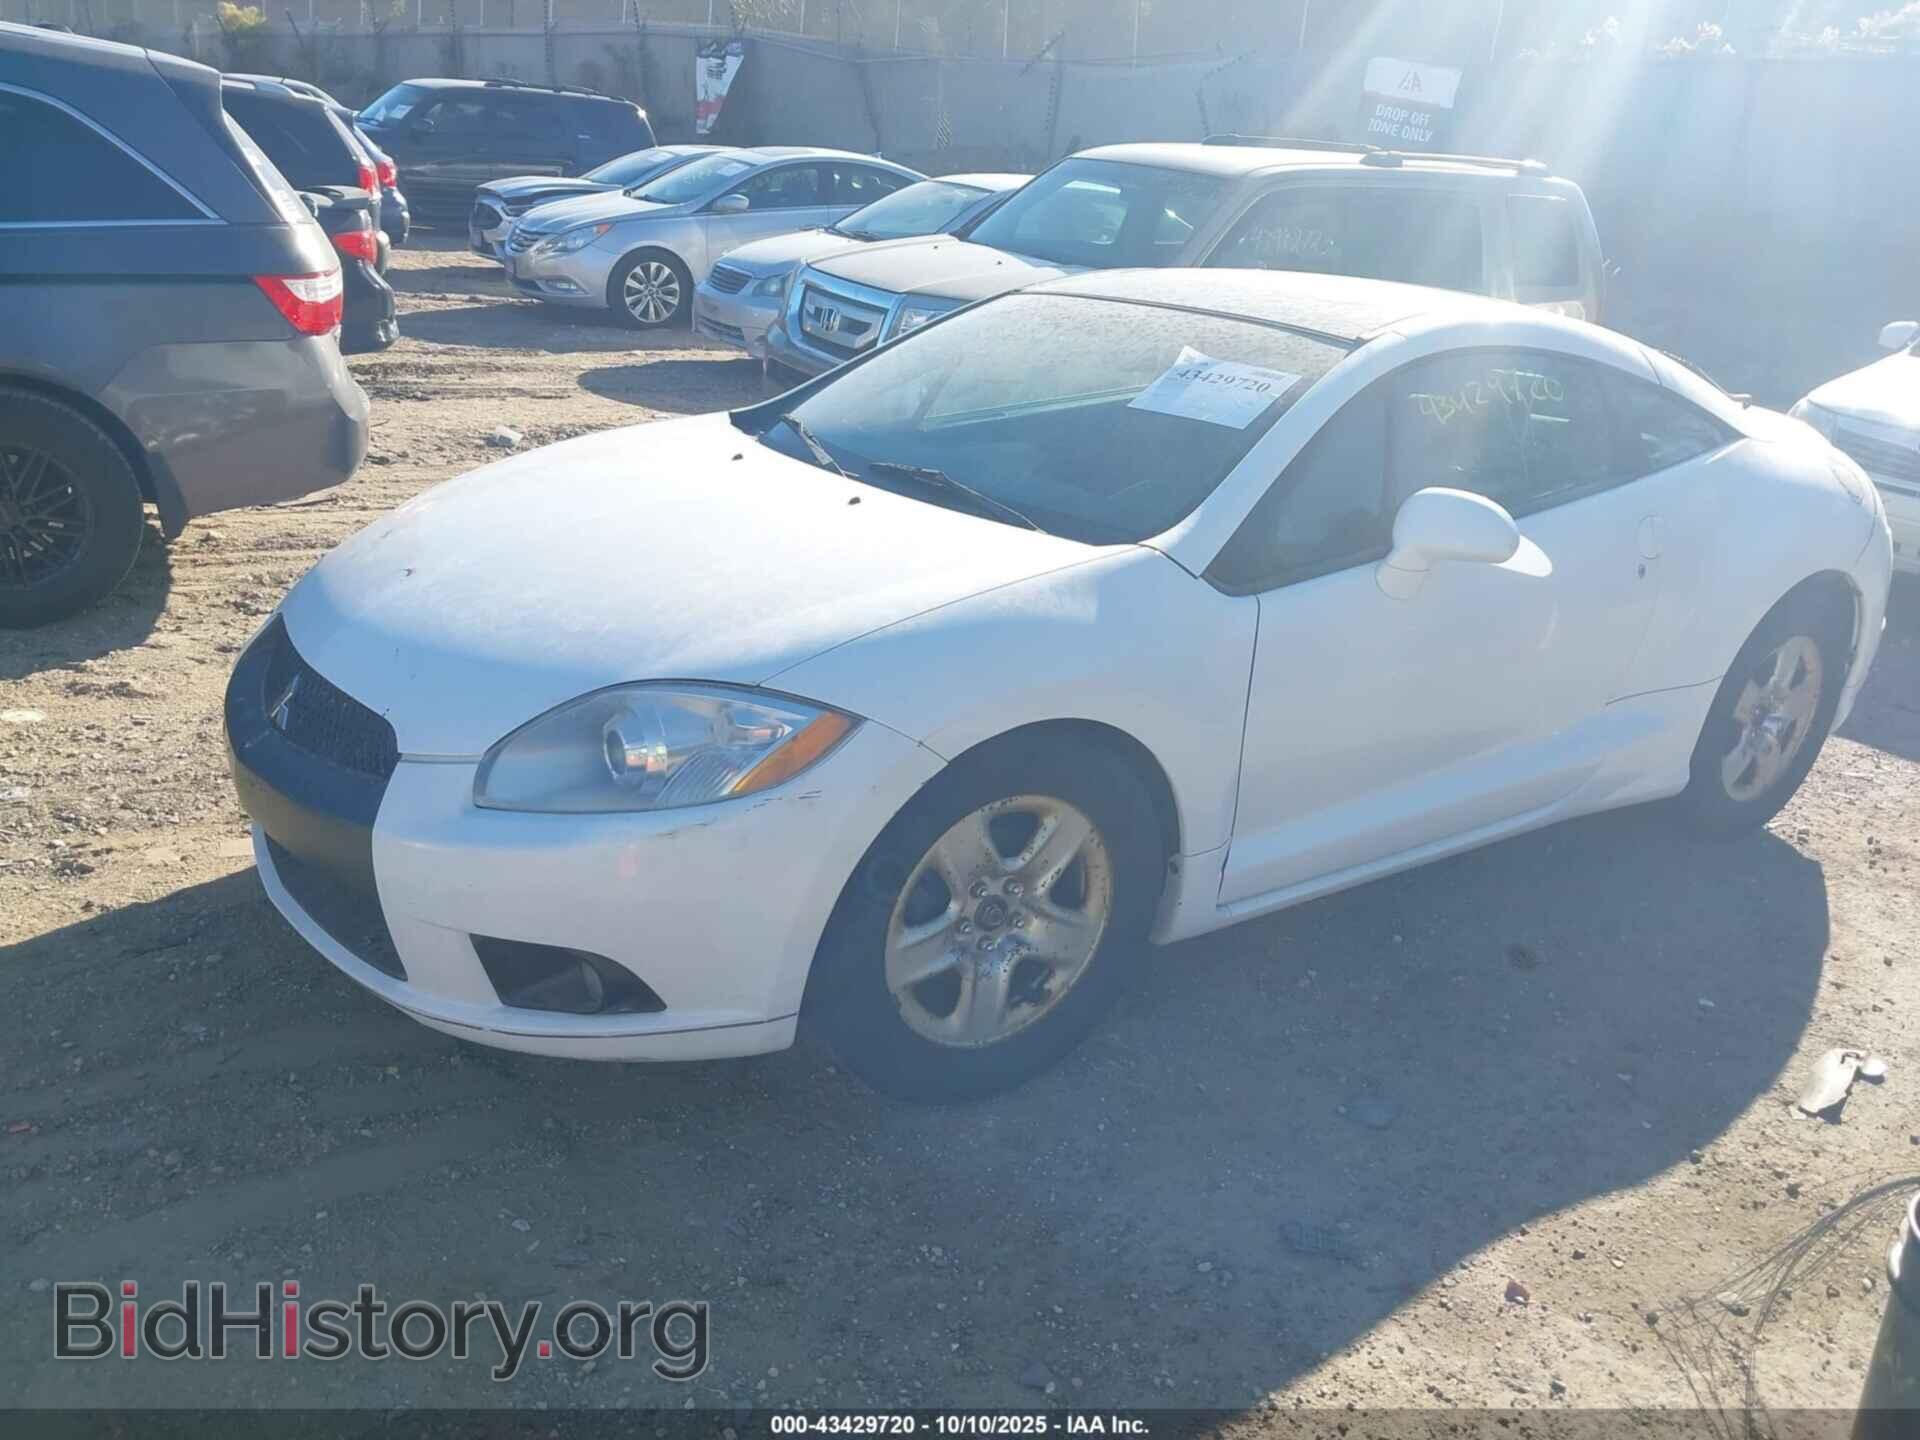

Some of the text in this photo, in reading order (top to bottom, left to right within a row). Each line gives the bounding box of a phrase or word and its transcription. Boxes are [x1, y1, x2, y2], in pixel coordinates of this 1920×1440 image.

[1375, 103, 1432, 128] DROP OFF
[1367, 117, 1433, 142] ZONE ONLY
[1176, 368, 1272, 393] 43429720
